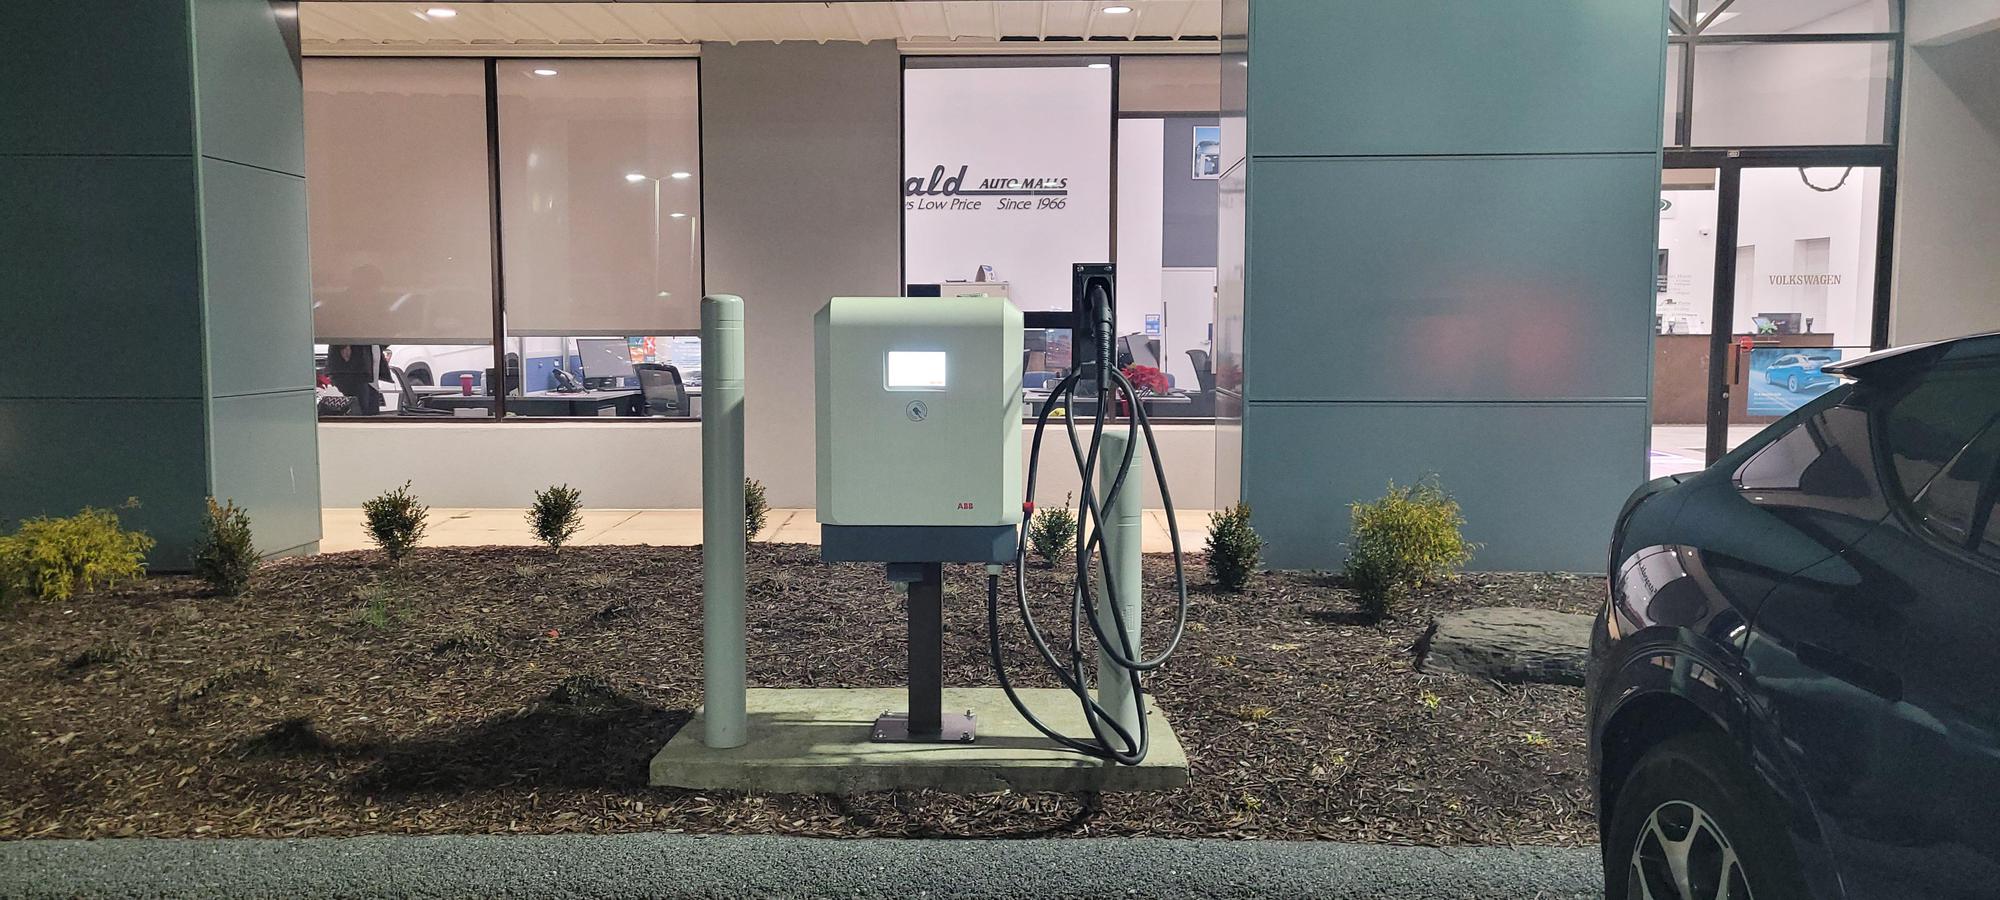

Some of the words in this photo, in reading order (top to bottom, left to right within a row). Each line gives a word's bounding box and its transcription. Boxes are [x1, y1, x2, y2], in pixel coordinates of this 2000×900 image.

[979, 178, 1018, 189] AUTO
[918, 198, 948, 210] Low
[950, 198, 982, 210] Price
[997, 198, 1032, 210] Since
[1036, 198, 1068, 210] 1966
[1769, 274, 1841, 285] VOLKSWAGEN
[957, 502, 974, 510] ABB
